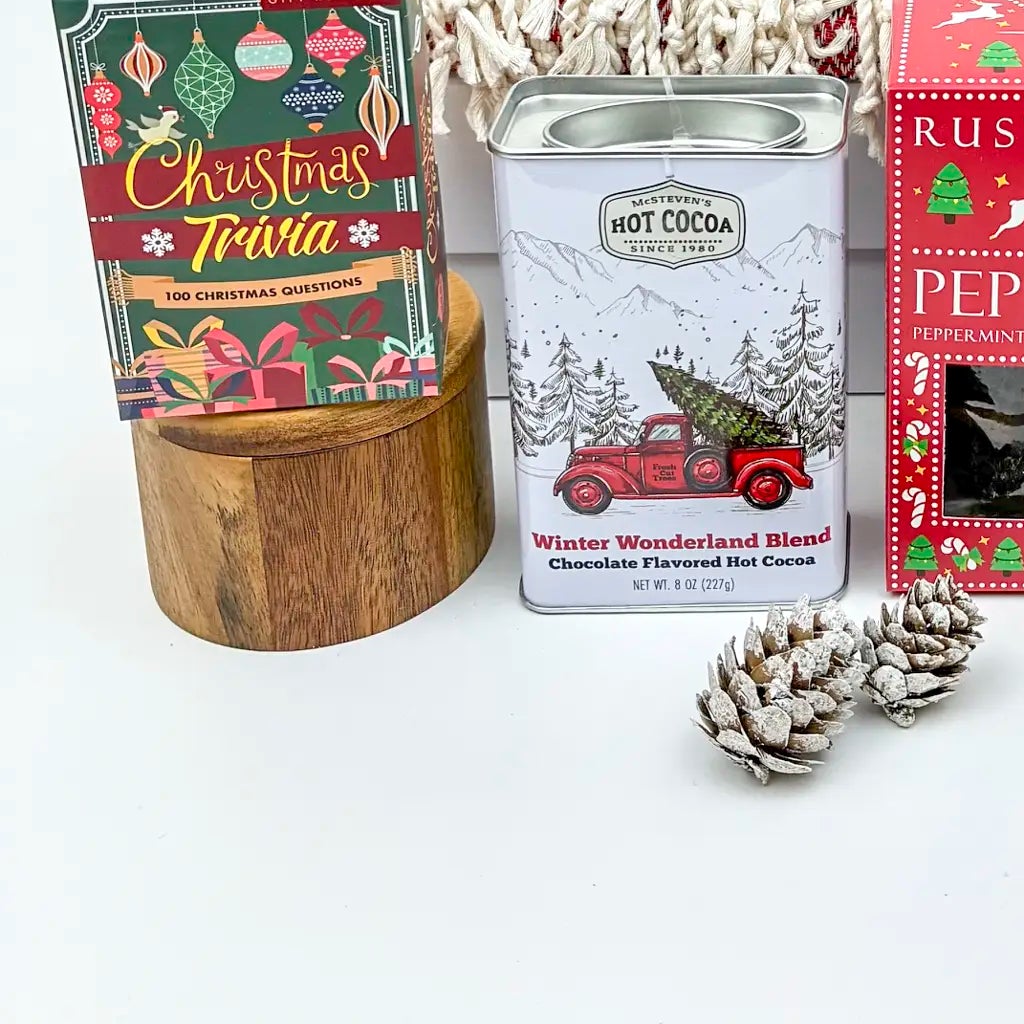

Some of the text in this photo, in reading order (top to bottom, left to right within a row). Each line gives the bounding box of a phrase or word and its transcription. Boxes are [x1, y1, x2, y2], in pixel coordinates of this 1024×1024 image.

[125, 138, 379, 211] Christmas
[631, 195, 712, 208] McSTEVEN'S
[611, 208, 734, 233] HOT COCOA
[183, 211, 340, 273] Trivia
[630, 245, 715, 253] SINCE 1980
[165, 276, 363, 301] 100 CHRISTMAS QUESTIONS
[531, 526, 832, 552] Winter Wonderland Blend
[548, 555, 816, 571] Chocolate Flavored Hot Cocoa
[633, 578, 735, 593] NET WT. 8 OZ (227g)
